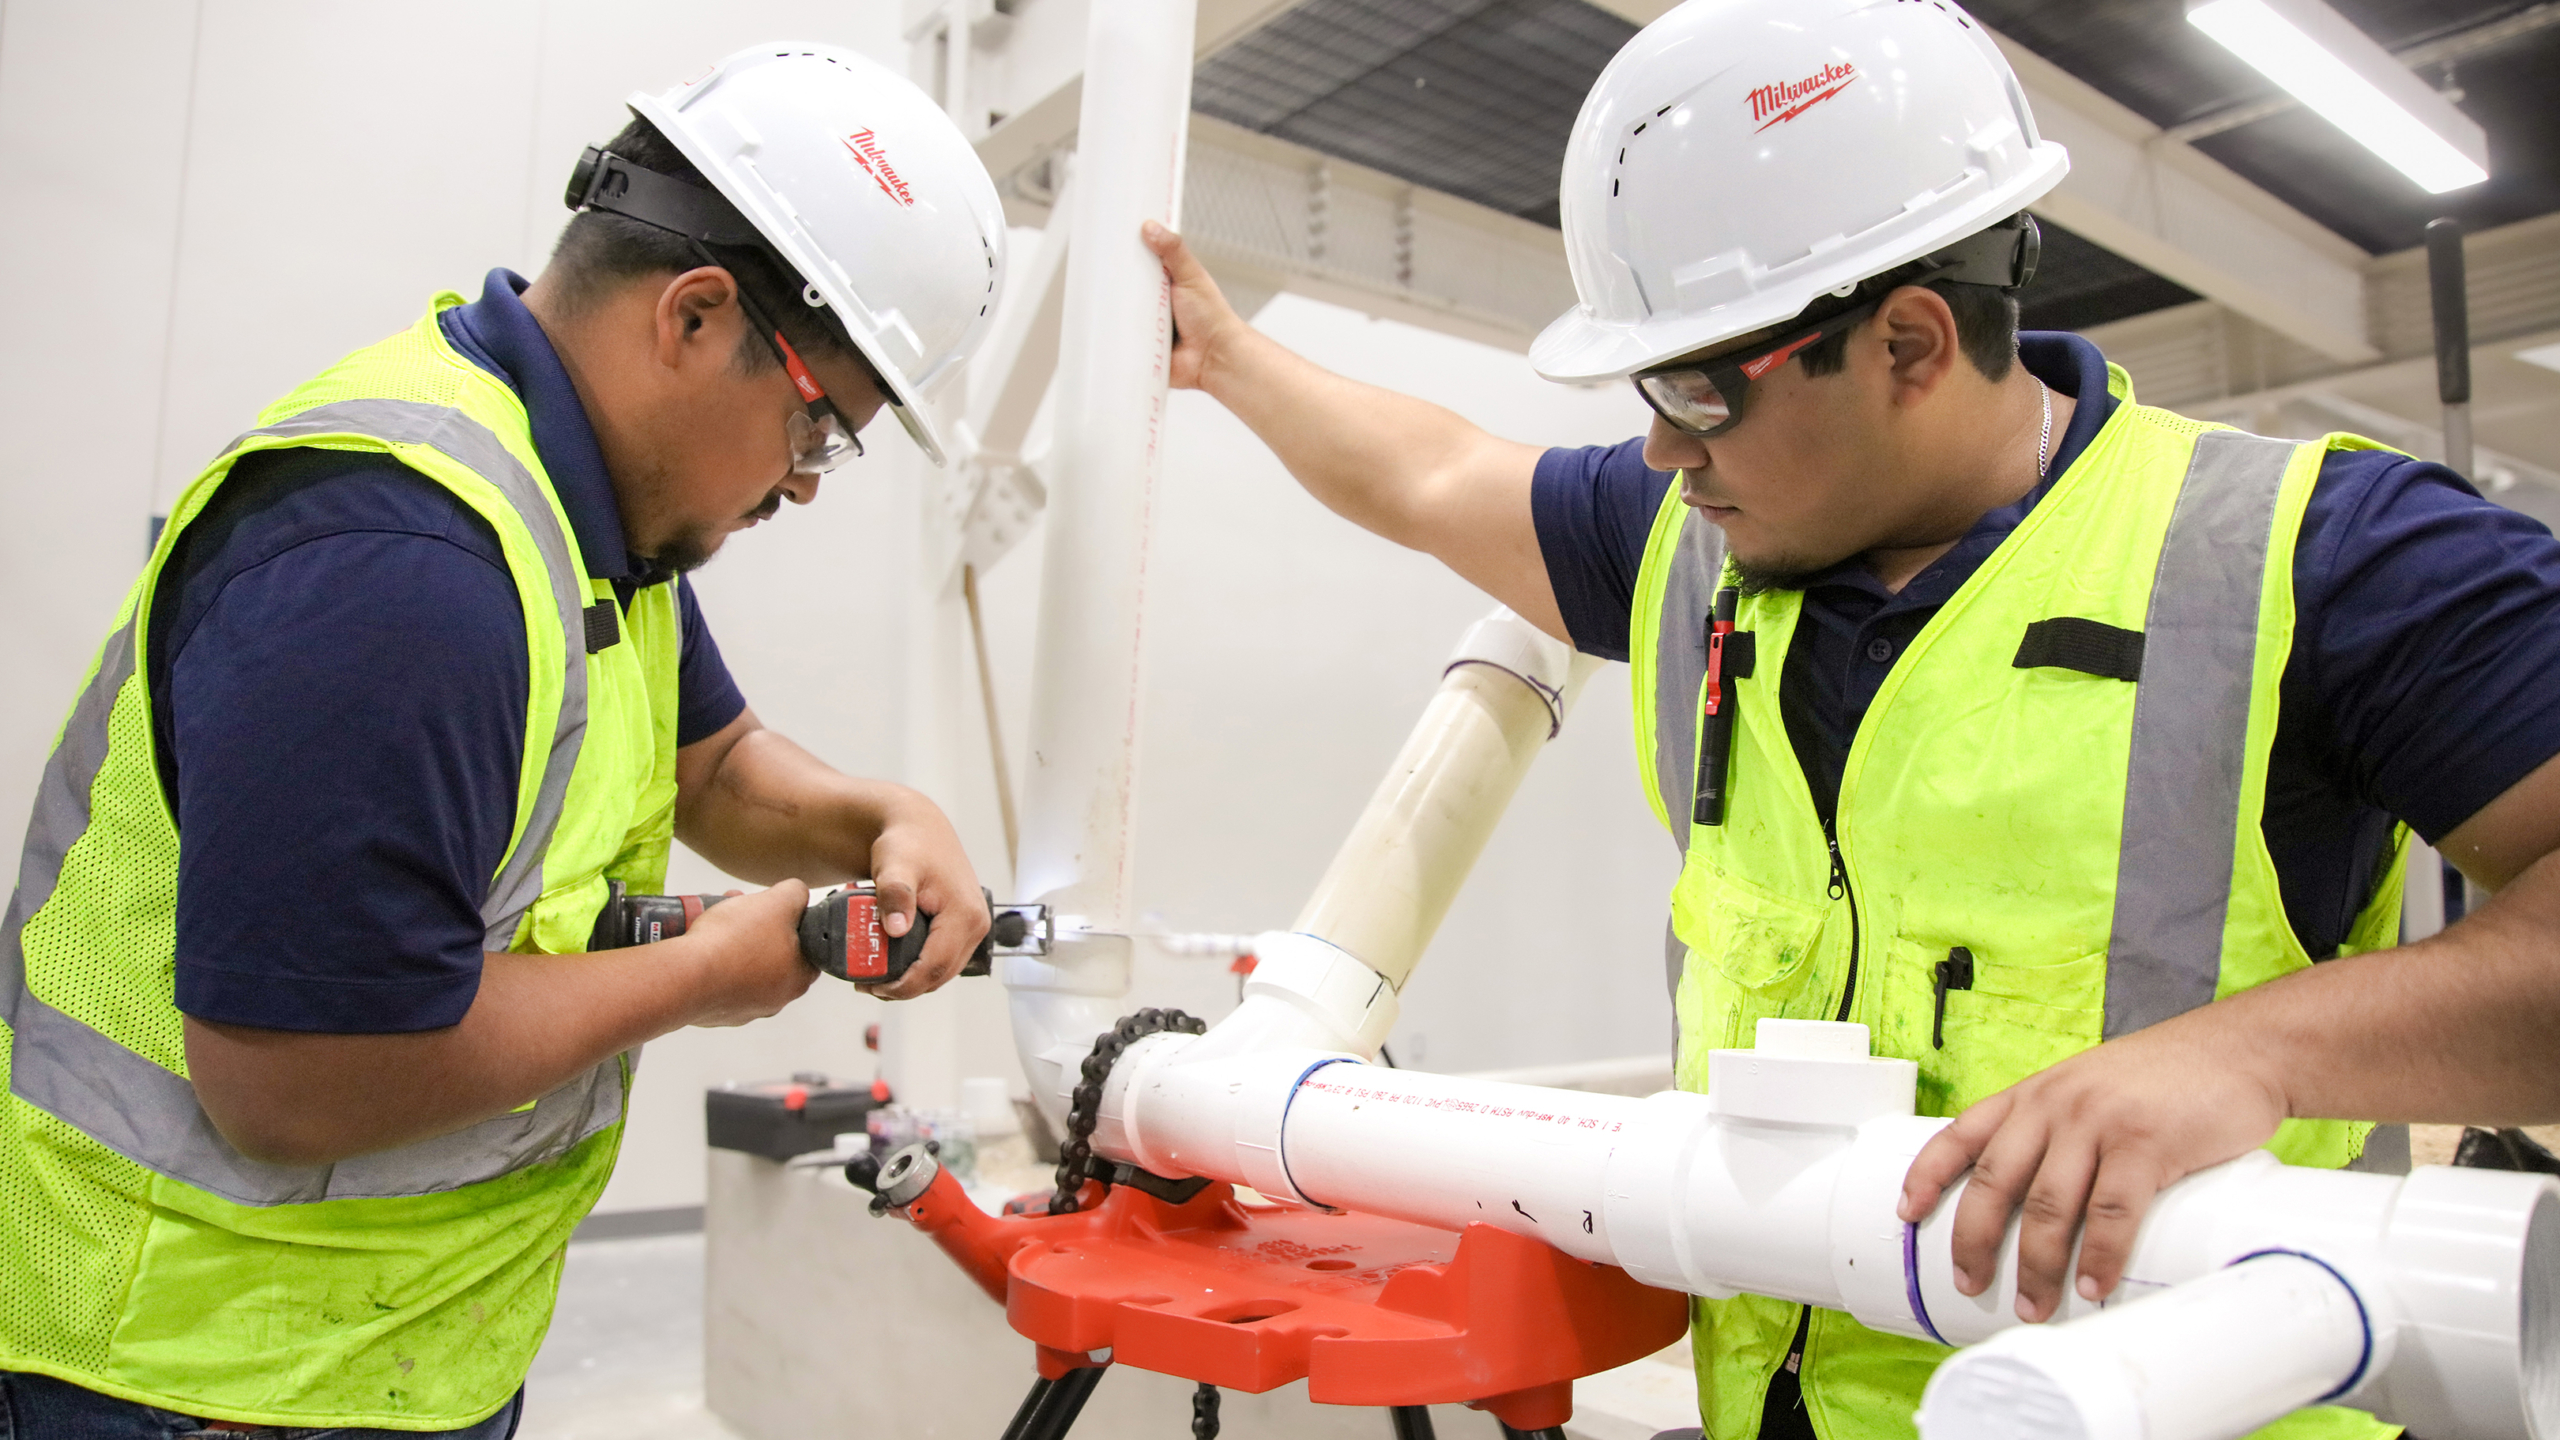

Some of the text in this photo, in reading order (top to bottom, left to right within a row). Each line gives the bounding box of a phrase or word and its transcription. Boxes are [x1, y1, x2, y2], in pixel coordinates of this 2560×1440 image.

[1743, 62, 1855, 121] Milwaukee
[849, 126, 914, 207] Milwaukee
[868, 904, 880, 967] FUEL
[1354, 1088, 1371, 1098] PSI
[1371, 1091, 1389, 1100] 260
[1388, 1093, 1402, 1102] PR
[1403, 1095, 1424, 1105] 1120
[1424, 1098, 1443, 1108] PVC
[1455, 1101, 1480, 1112] 2665
[1480, 1104, 1490, 1114] D
[1490, 1106, 1515, 1117] ASTM
[1557, 1115, 1570, 1125] 40
